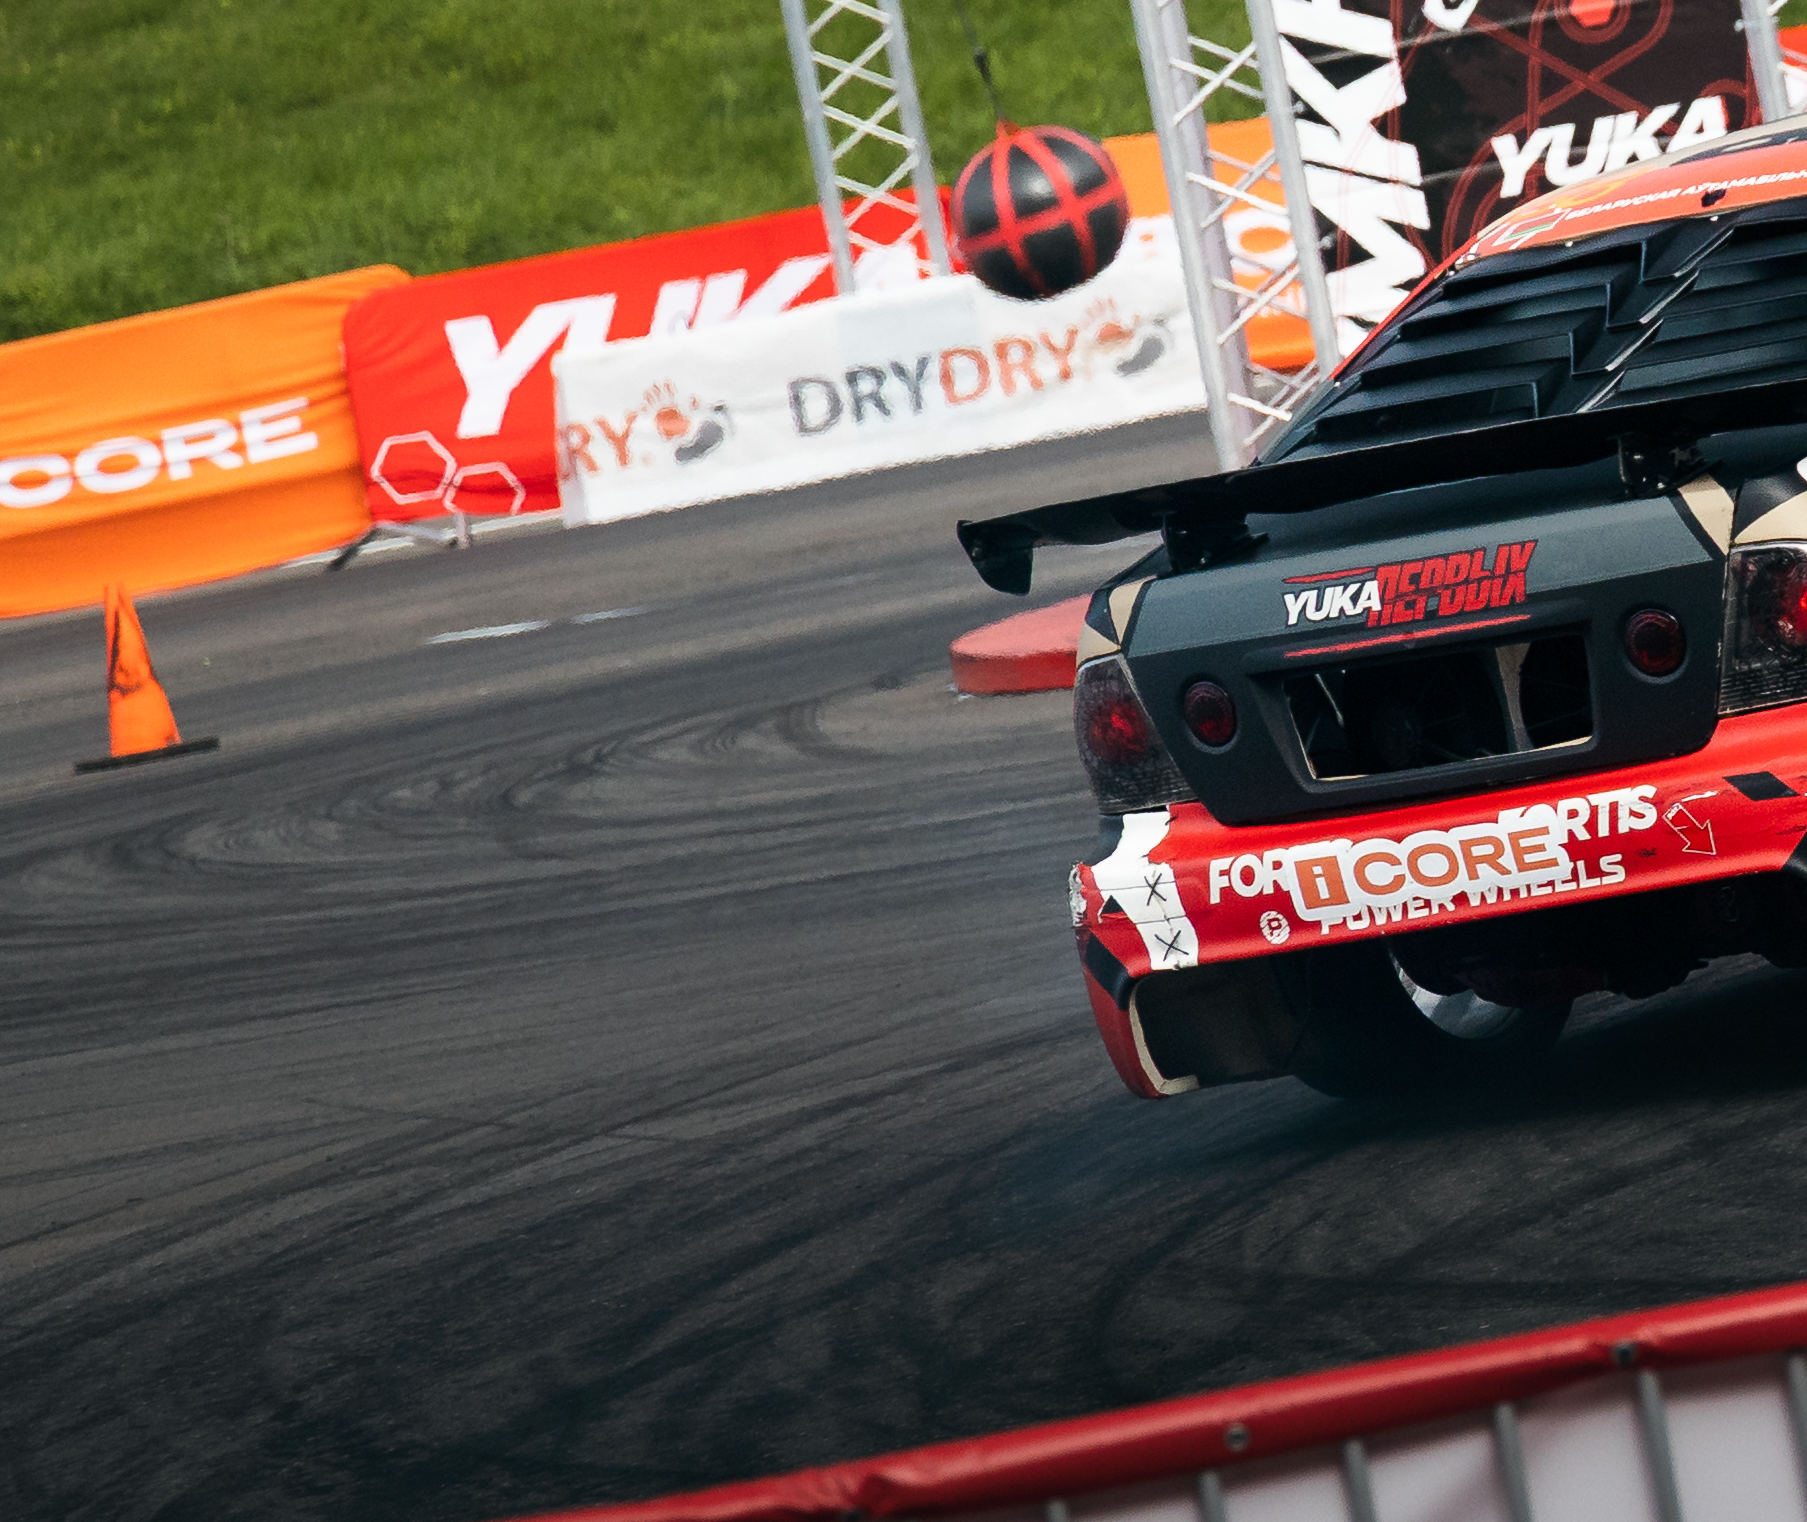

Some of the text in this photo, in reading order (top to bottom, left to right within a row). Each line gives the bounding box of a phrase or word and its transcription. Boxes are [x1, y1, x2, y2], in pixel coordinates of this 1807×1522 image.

[1490, 95, 1730, 199] YUKA
[788, 323, 1080, 437] DRYDRY
[1283, 579, 1383, 626] YUKA
[1498, 783, 1659, 846] RTIS
